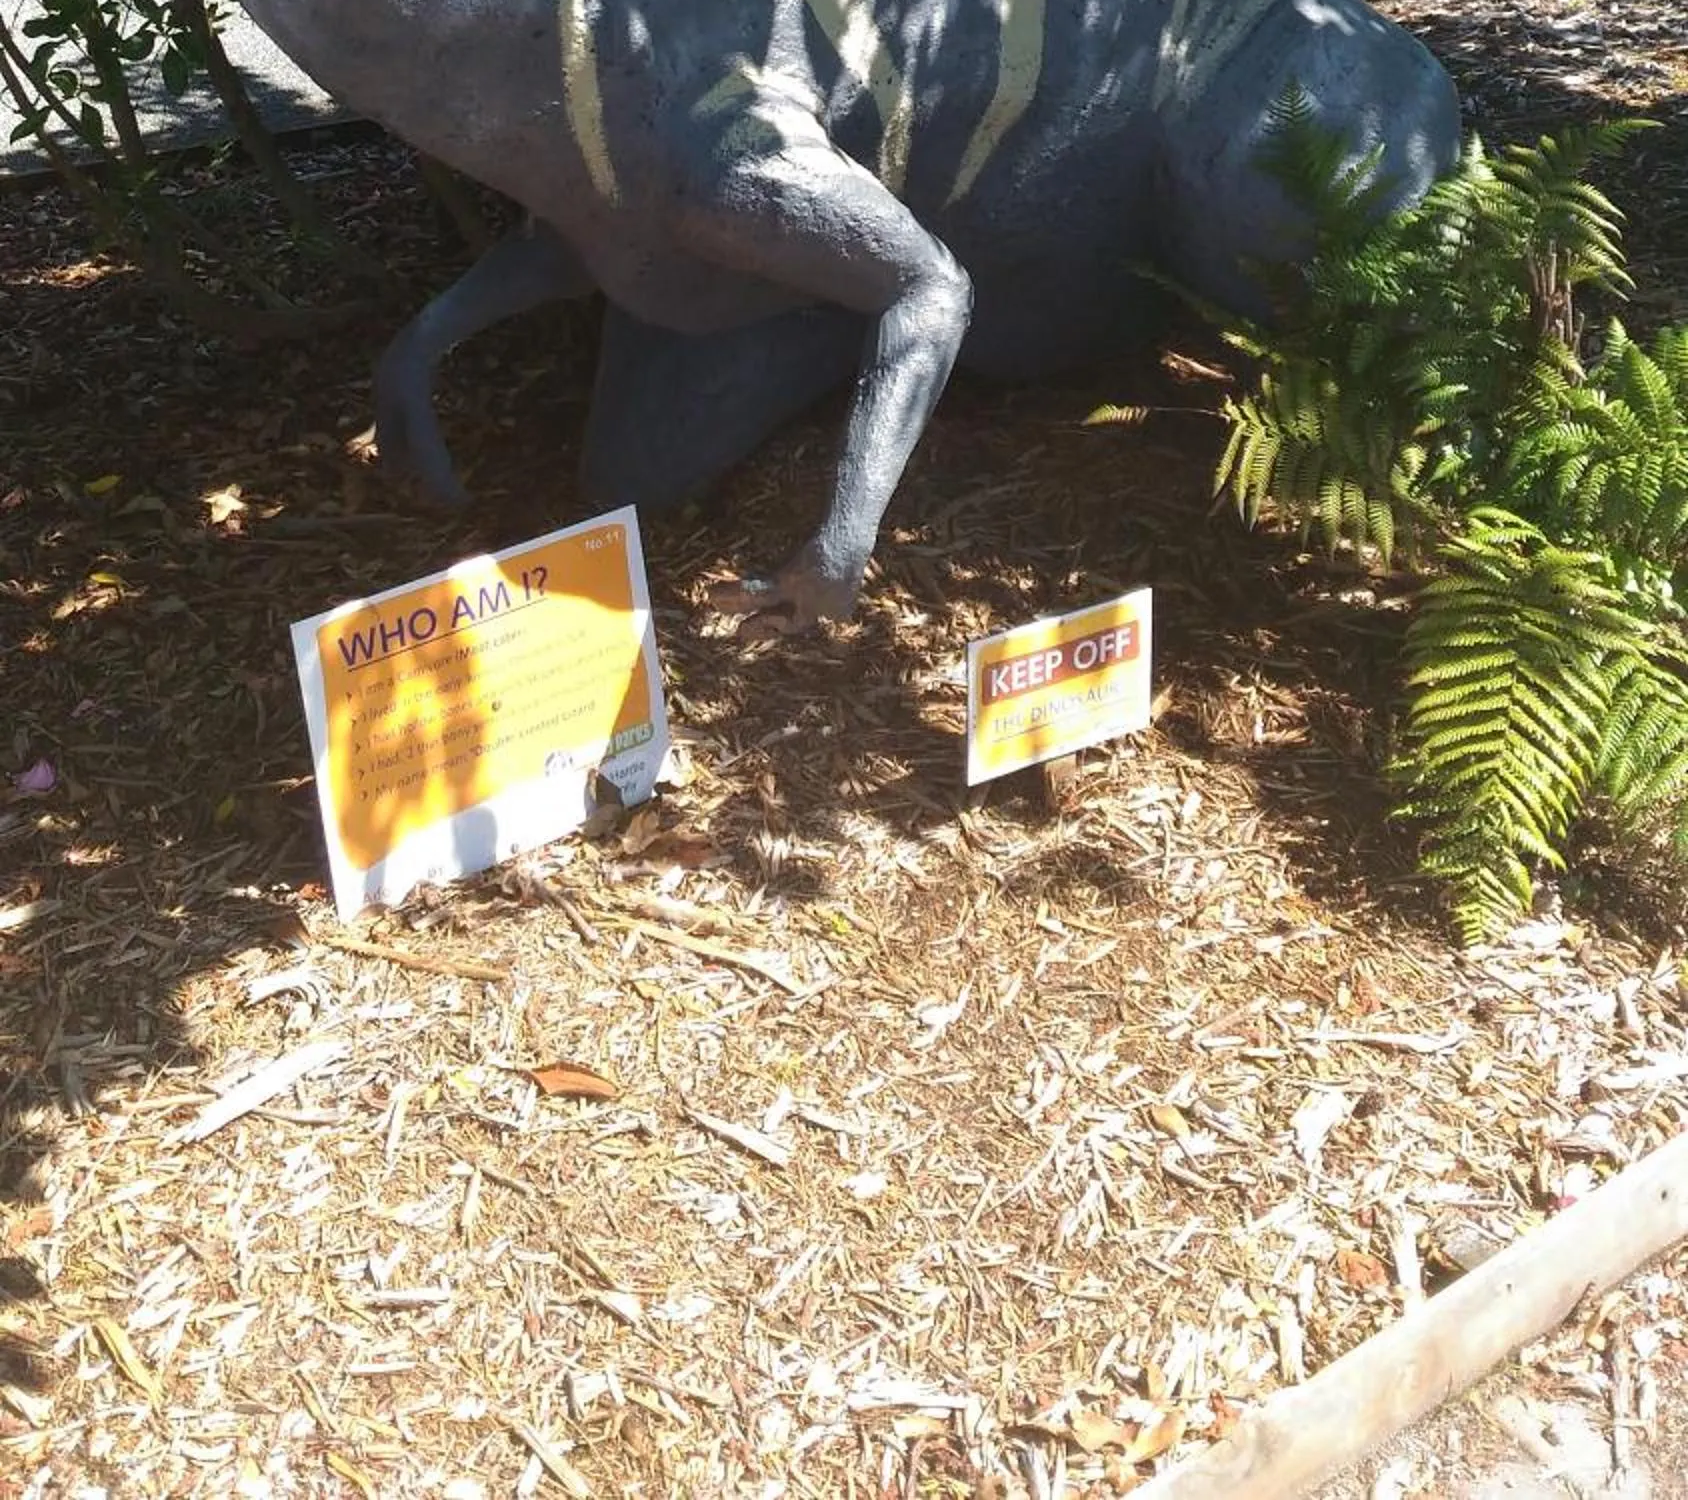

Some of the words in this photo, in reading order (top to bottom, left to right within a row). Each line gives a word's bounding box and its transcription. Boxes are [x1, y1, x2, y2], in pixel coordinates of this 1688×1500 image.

[338, 608, 436, 667] WHO
[452, 581, 510, 629] AM
[521, 566, 549, 602] I?
[991, 649, 1063, 697] KEEP
[1073, 627, 1131, 669] OFF
